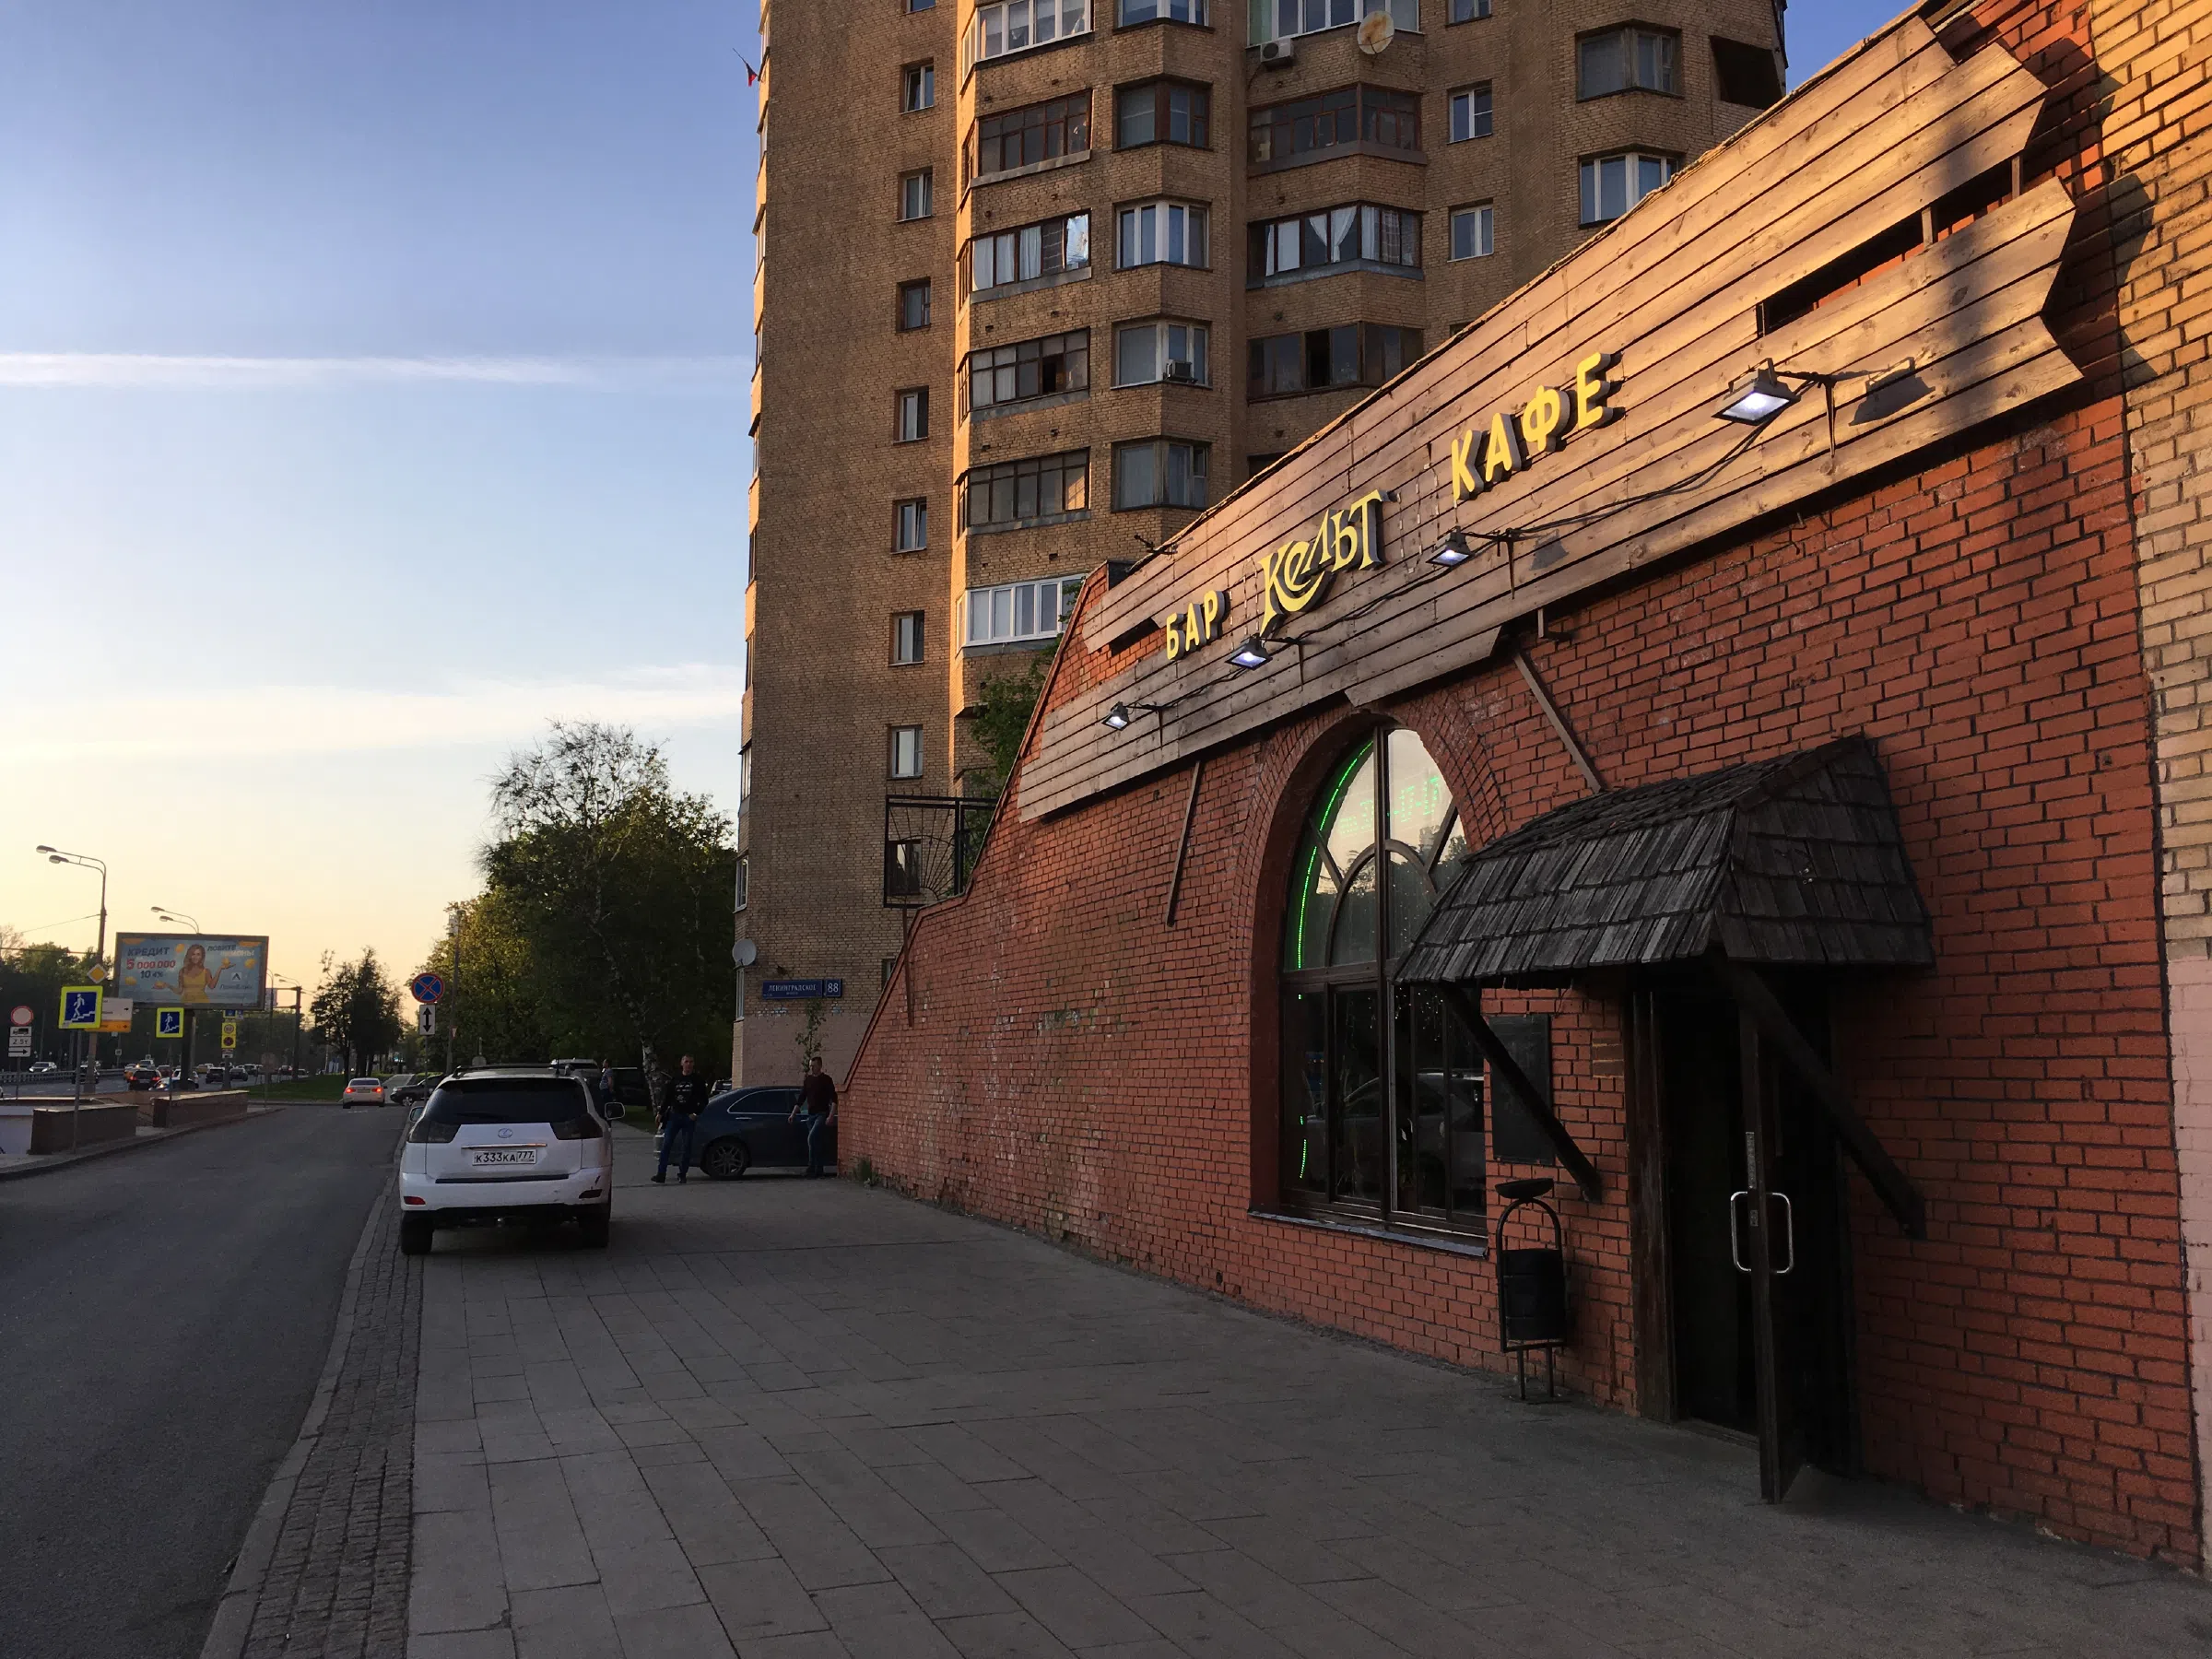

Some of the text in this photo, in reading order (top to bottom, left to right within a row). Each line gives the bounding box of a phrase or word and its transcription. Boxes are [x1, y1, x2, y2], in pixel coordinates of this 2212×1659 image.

[1166, 590, 1228, 661] БАР
[1451, 351, 1615, 500] КАФЕ
[127, 947, 171, 957] КРЕДИТ
[126, 958, 135, 970] 5
[768, 982, 839, 993] ЛЕНИНГРАДСКОЕ 88
